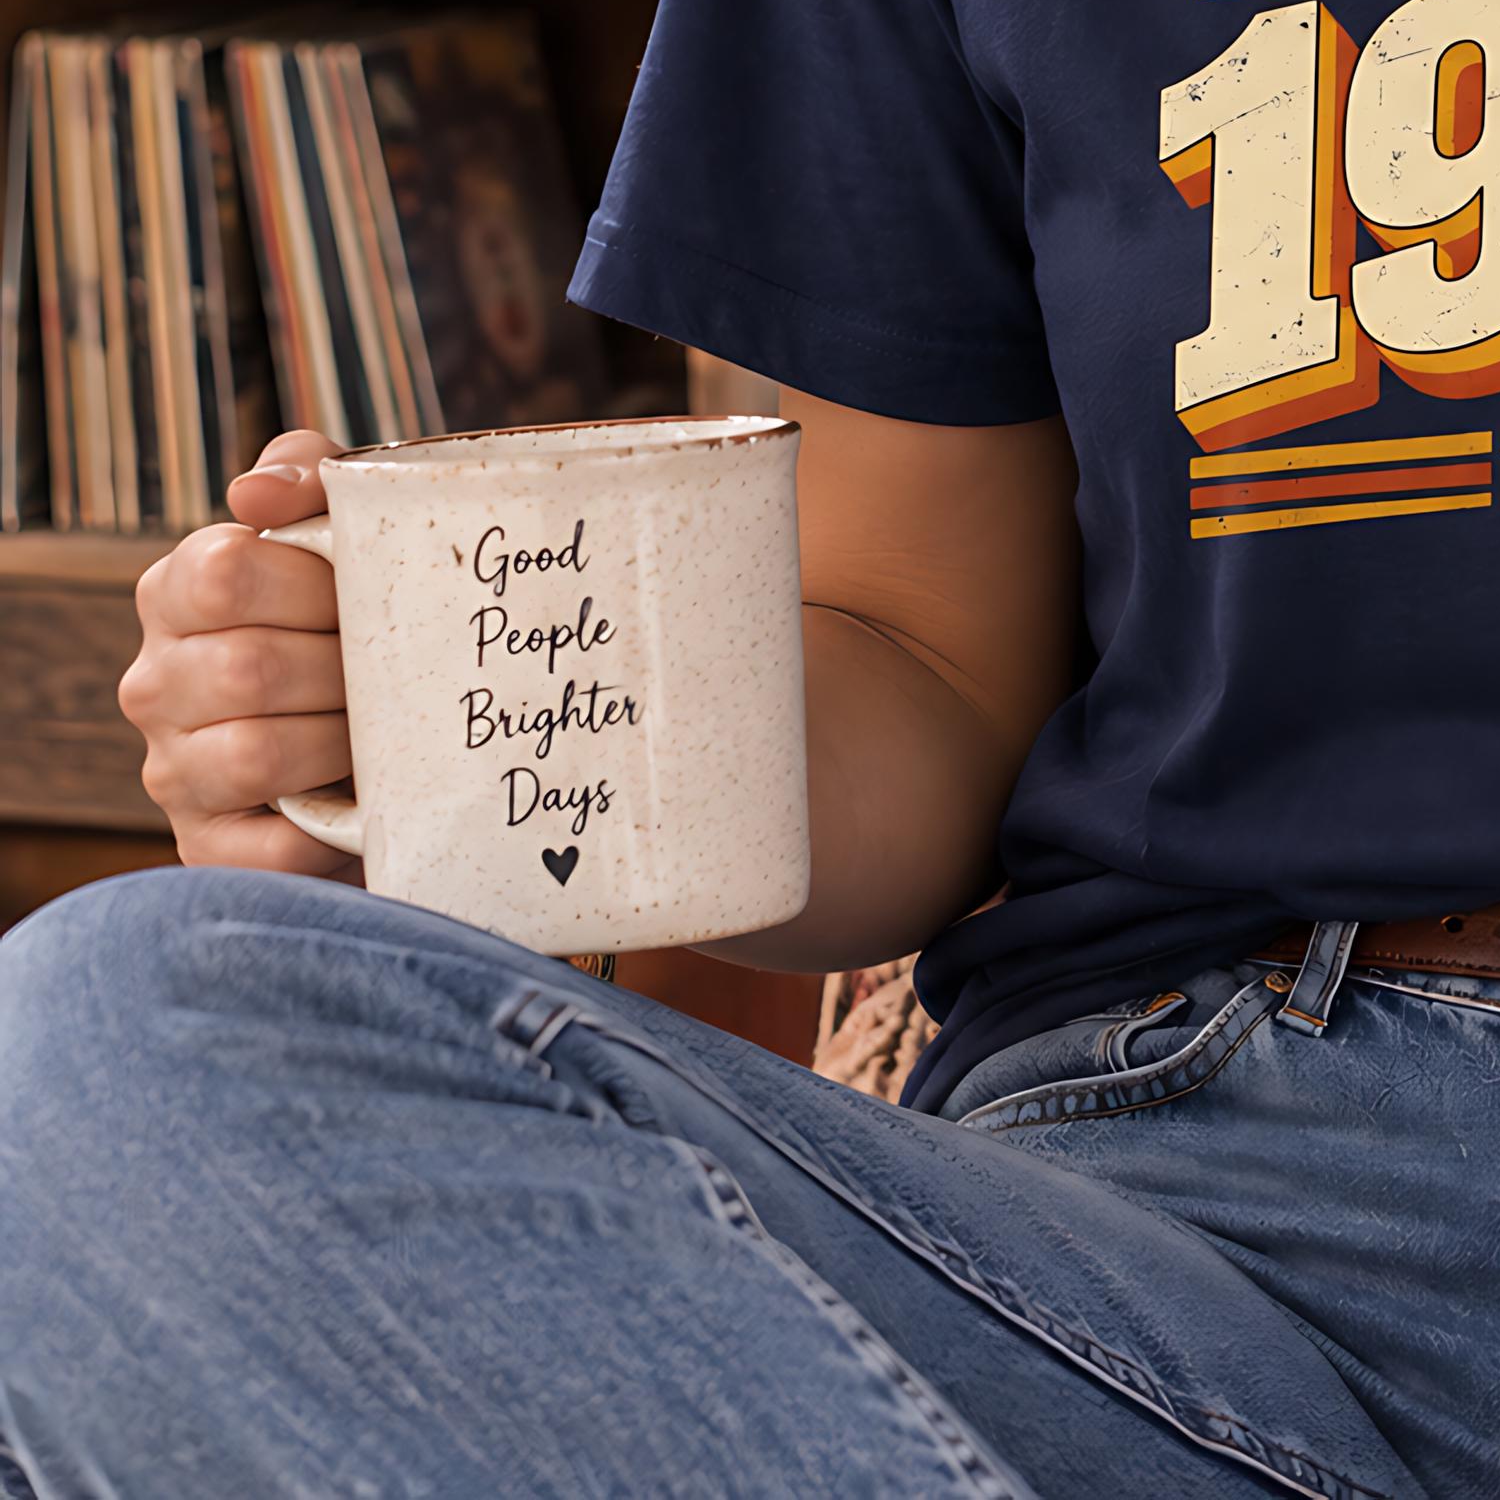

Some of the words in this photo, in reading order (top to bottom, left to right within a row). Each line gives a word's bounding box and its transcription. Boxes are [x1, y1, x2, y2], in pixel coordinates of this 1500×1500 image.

[473, 519, 590, 597] Good
[468, 597, 618, 674] People
[459, 679, 644, 760] Brighter
[500, 767, 617, 836] Days
